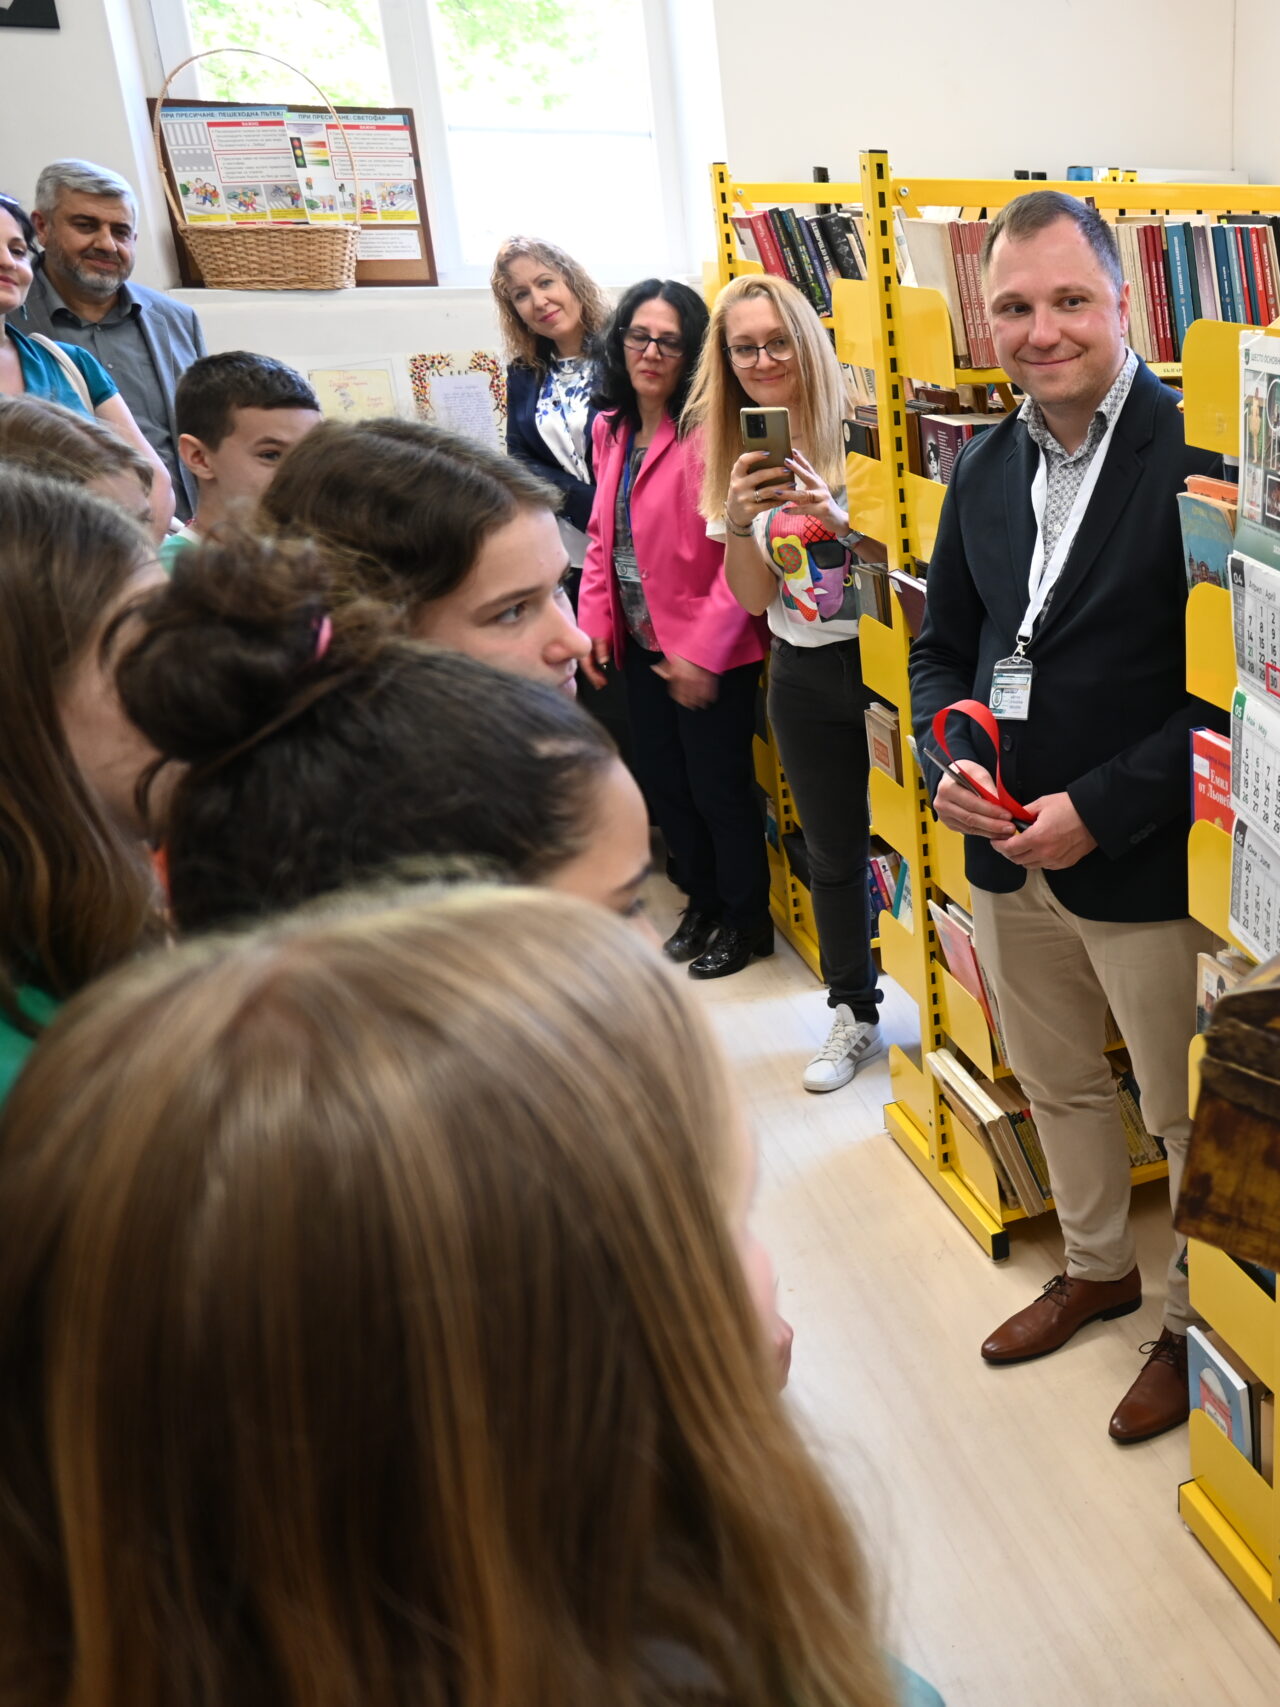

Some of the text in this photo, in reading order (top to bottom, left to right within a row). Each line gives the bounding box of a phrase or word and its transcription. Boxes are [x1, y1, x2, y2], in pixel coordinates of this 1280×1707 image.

[1234, 573, 1242, 586] 04
[1272, 612, 1276, 624] 2
[1260, 622, 1264, 634] 8
[1272, 628, 1276, 640] 9
[1247, 630, 1254, 642] 14
[1259, 636, 1265, 650] 15
[1271, 644, 1277, 657] 16
[1259, 652, 1266, 666] 22
[1247, 660, 1254, 674] 28
[1270, 675, 1278, 689] 30
[1234, 706, 1242, 718] 05
[1209, 768, 1230, 792] Емил
[1198, 784, 1207, 794] от
[1274, 804, 1280, 818] 22
